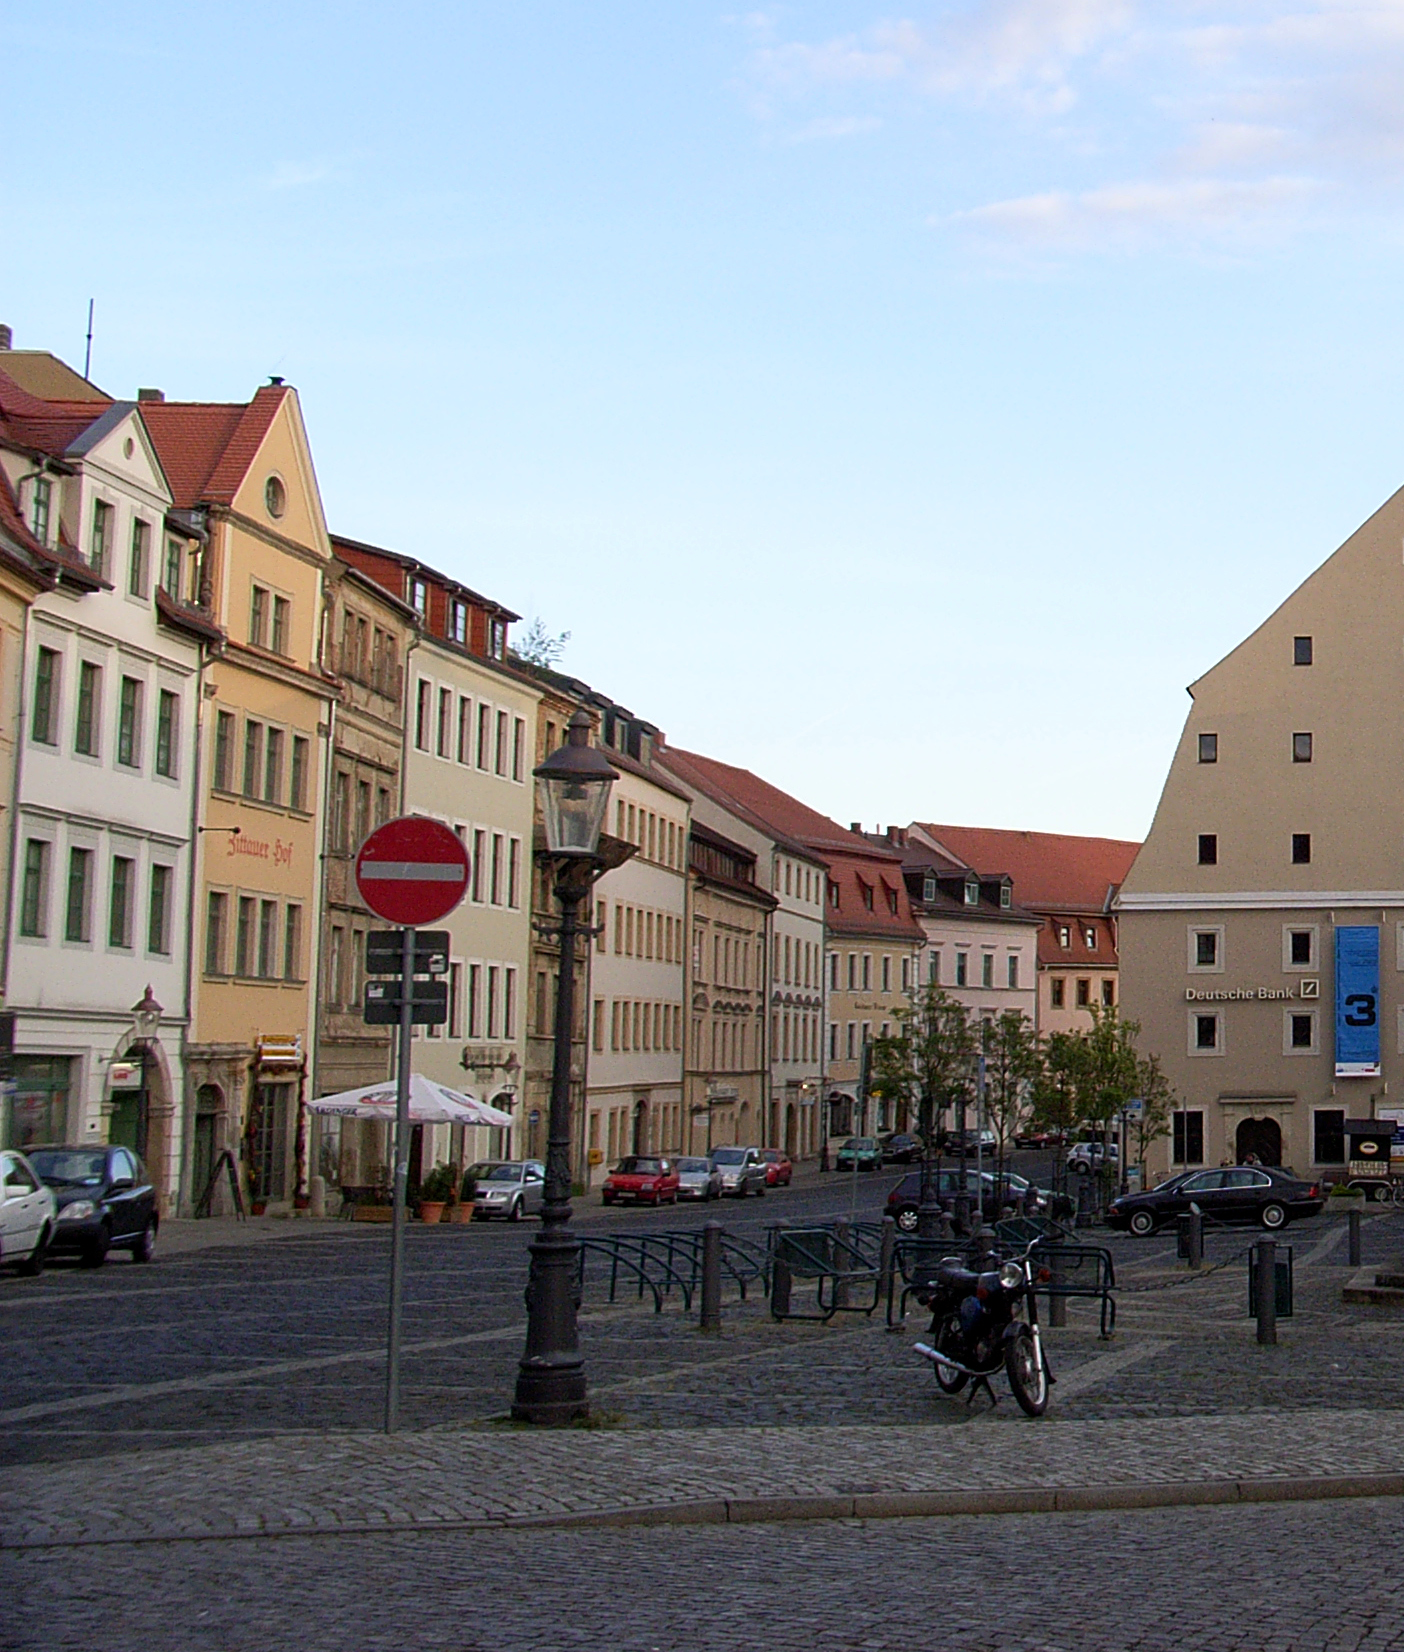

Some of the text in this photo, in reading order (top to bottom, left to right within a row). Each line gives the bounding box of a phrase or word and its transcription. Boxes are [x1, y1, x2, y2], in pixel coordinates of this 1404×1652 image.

[227, 834, 294, 868] Zittauer Hof
[1186, 987, 1294, 1000] Deutsche Bank
[1345, 994, 1376, 1026] 3
